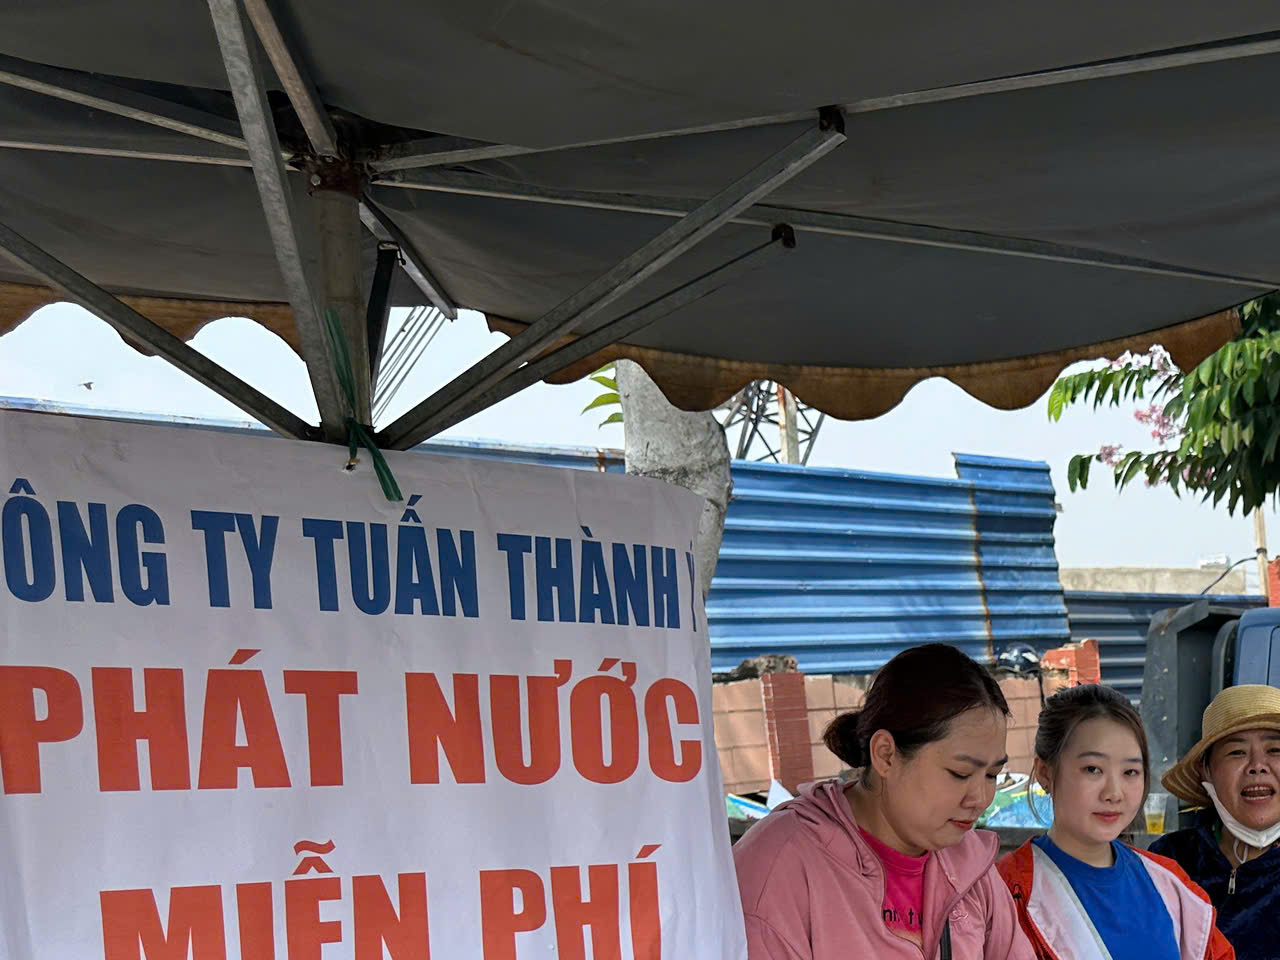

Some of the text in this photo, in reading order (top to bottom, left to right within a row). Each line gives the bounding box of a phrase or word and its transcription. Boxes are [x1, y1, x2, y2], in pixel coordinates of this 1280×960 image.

[191, 510, 280, 610] TY
[302, 495, 480, 618] TUẤN
[497, 525, 681, 628] THÀNH
[0, 649, 703, 794] PHÁT NƯỚC
